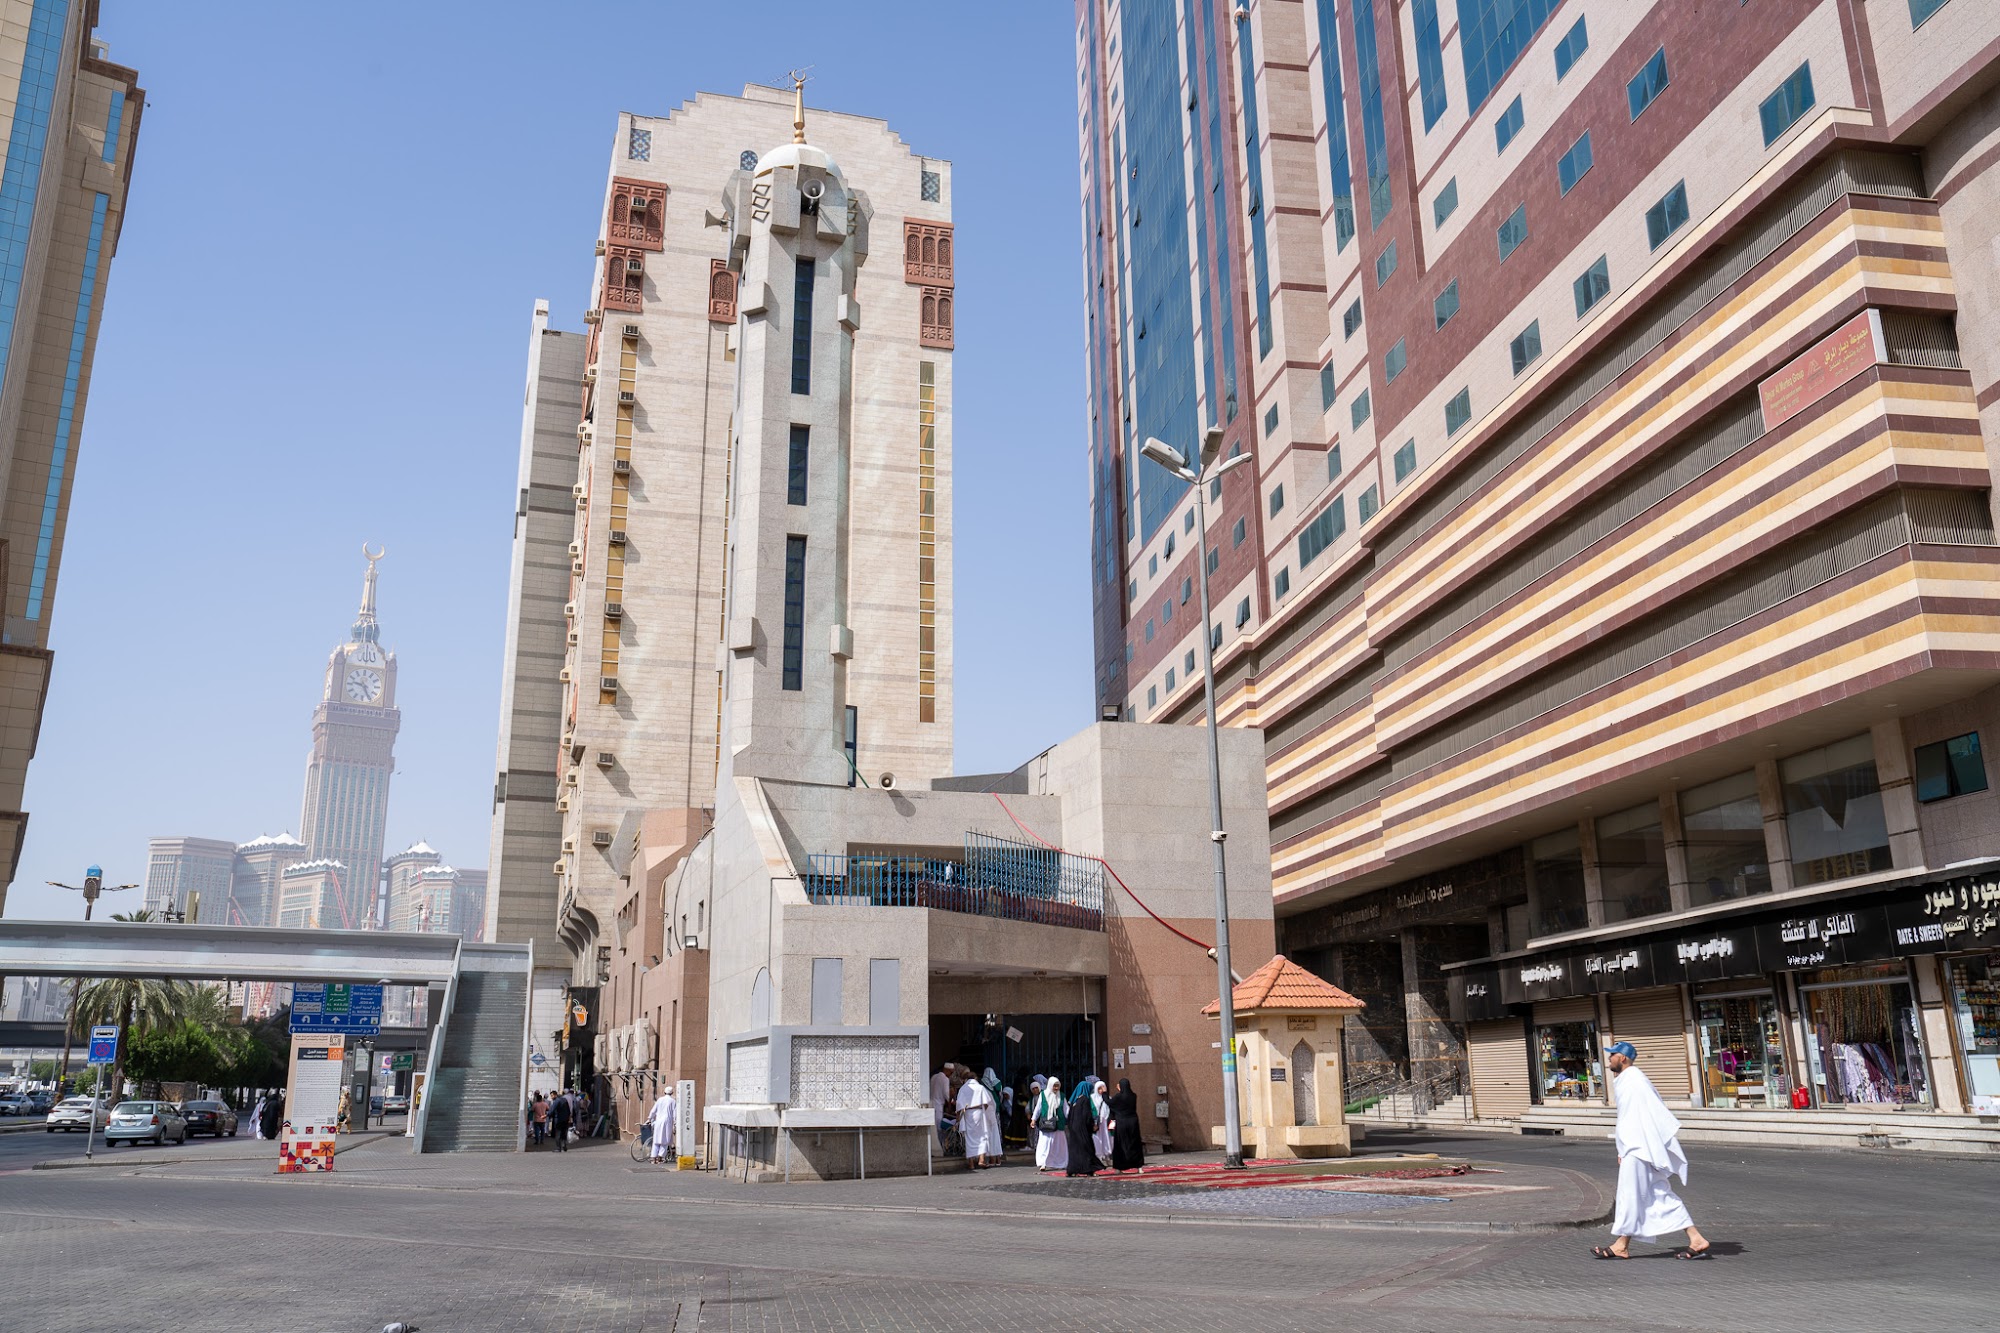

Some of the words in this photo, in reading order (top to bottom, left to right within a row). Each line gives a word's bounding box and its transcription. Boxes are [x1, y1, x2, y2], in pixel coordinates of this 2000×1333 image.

[1972, 876, 2000, 910] جوة
[1820, 914, 1856, 948] المالكي
[1896, 928, 1914, 945] DATE
[1913, 926, 1919, 944] &
[1918, 924, 1944, 942] SWEETS
